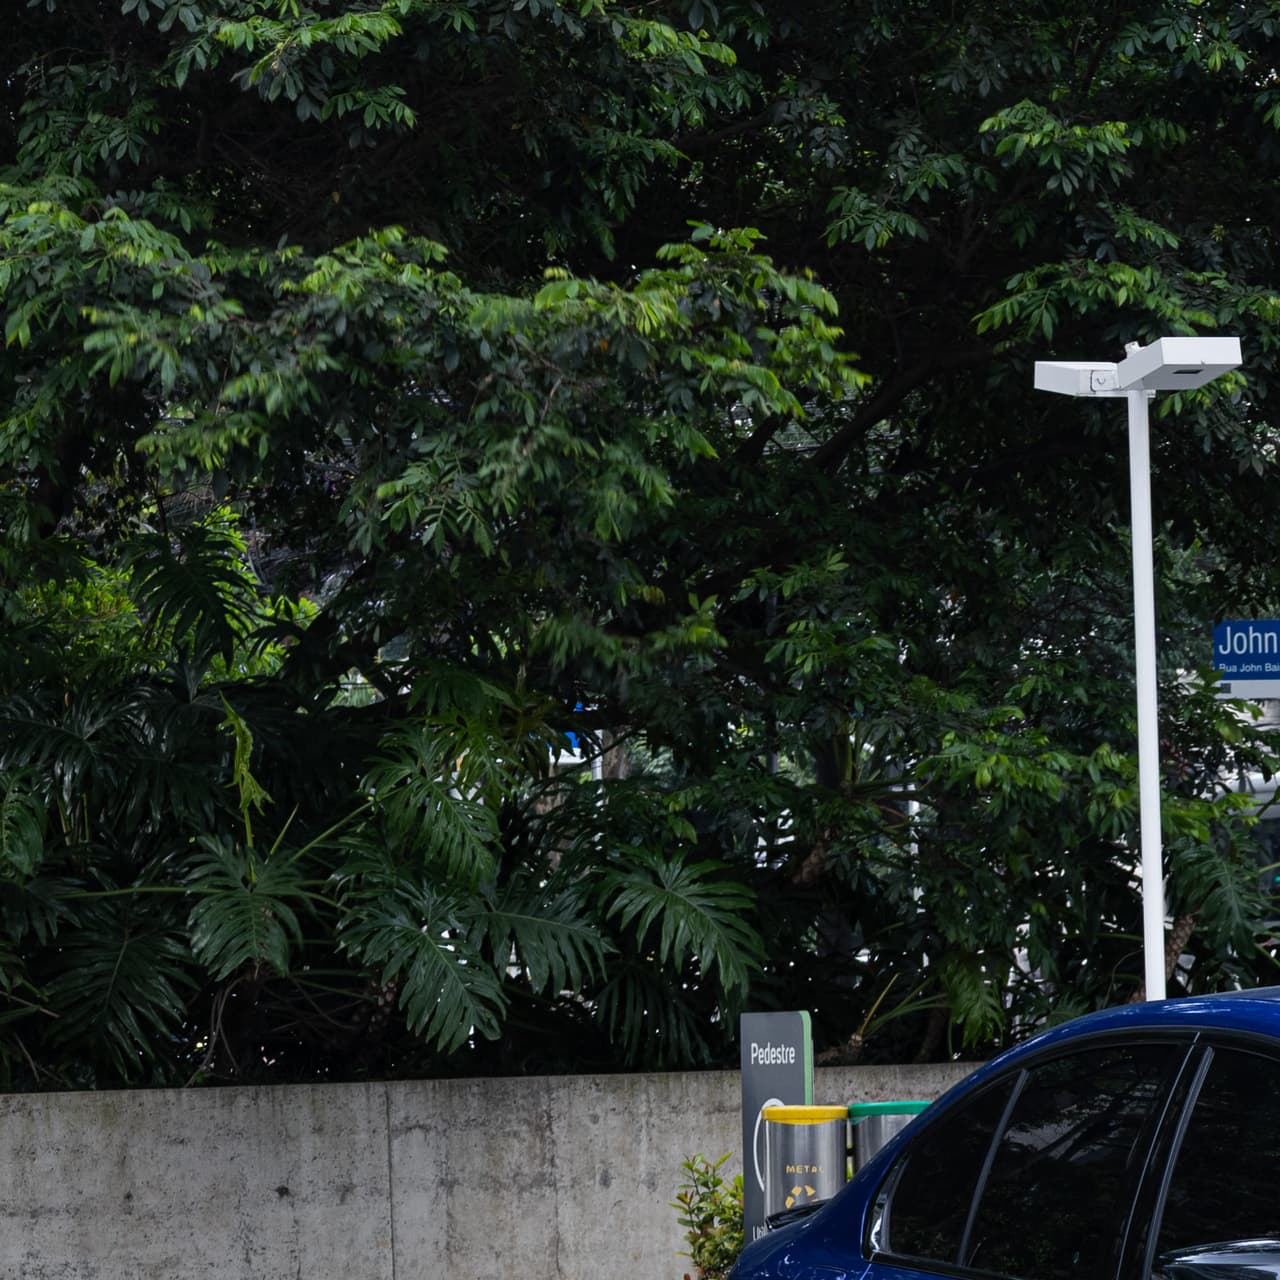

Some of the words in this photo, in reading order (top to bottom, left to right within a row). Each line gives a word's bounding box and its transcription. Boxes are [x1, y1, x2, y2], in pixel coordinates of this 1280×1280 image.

[1219, 626, 1277, 654] John
[1218, 663, 1237, 672] Rua
[1240, 663, 1263, 672] John
[751, 1041, 795, 1065] Pedestre
